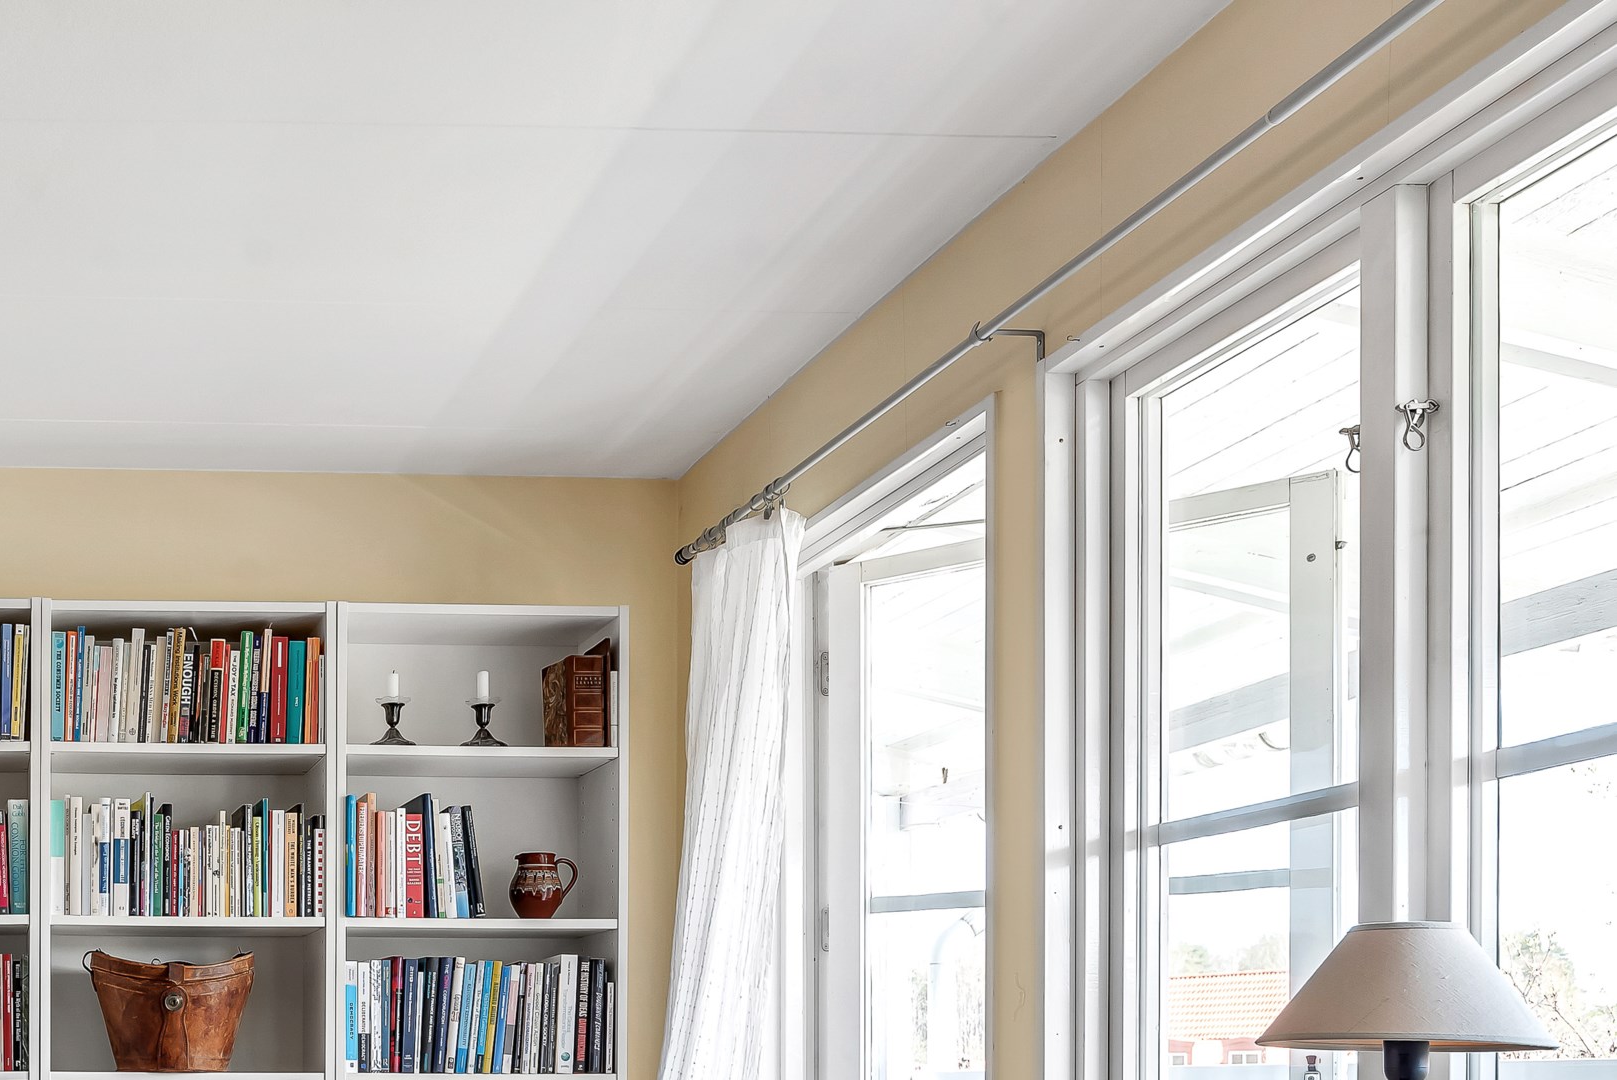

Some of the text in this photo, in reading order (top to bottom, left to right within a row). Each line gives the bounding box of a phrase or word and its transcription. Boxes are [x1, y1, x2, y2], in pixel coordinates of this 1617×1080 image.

[173, 656, 182, 689] Institutions
[181, 654, 193, 704] ENOUGH
[11, 822, 19, 863] COMMON
[406, 820, 421, 866] DEBT
[581, 962, 589, 972] THE
[580, 972, 589, 993] HISTORY
[579, 1002, 588, 1017] IDEAS
[579, 1018, 587, 1033] DAVID
